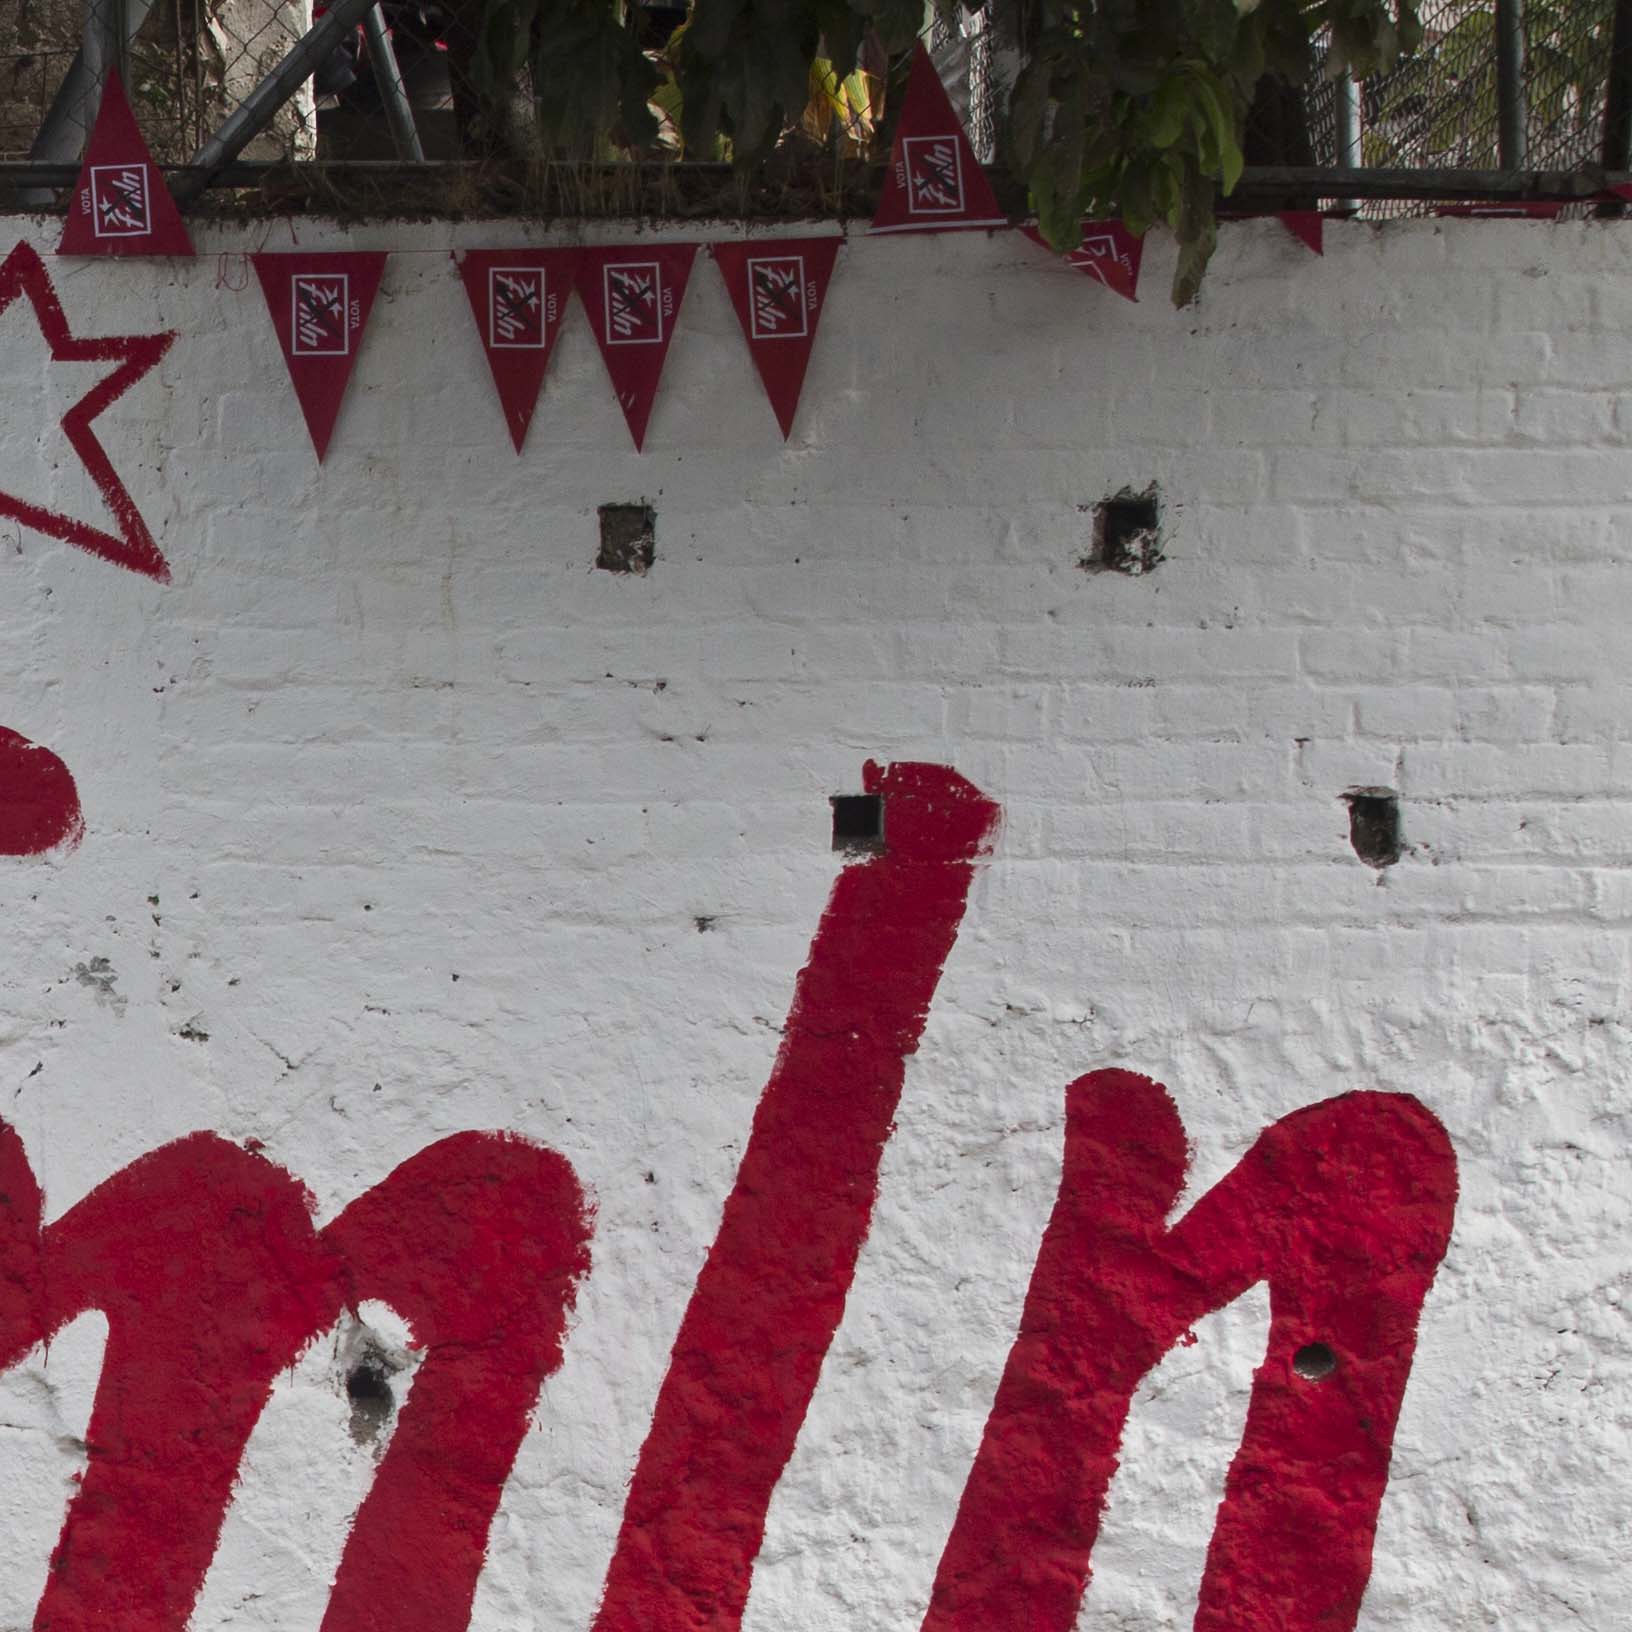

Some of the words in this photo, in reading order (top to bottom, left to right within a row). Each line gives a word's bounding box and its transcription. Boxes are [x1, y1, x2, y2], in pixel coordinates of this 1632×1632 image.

[894, 160, 906, 189] VOTA
[80, 187, 91, 216] VOTA
[546, 292, 558, 323] VOTA
[662, 287, 674, 317] VOTA
[806, 280, 817, 310] VOTA
[349, 299, 361, 329] VOTA
